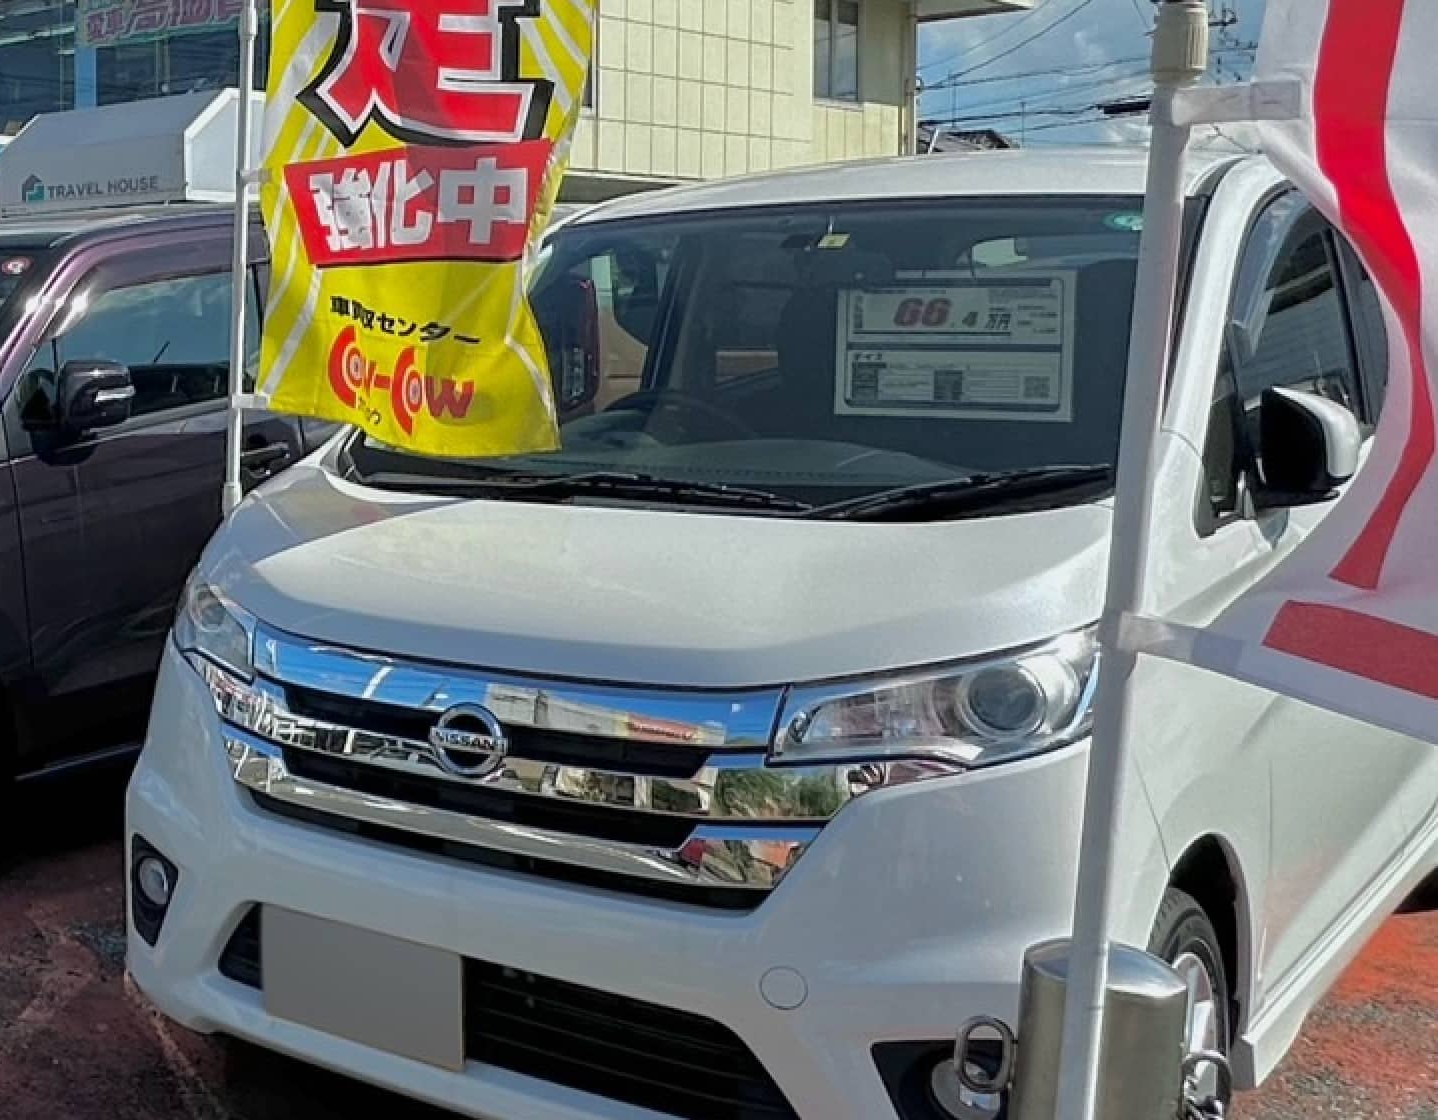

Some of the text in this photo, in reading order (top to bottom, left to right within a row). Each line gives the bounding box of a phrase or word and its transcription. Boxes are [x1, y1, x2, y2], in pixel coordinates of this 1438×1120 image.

[48, 174, 159, 200] TRAVEL HOUSE
[309, 157, 529, 252] 強化中
[431, 730, 506, 755] NISSAN
